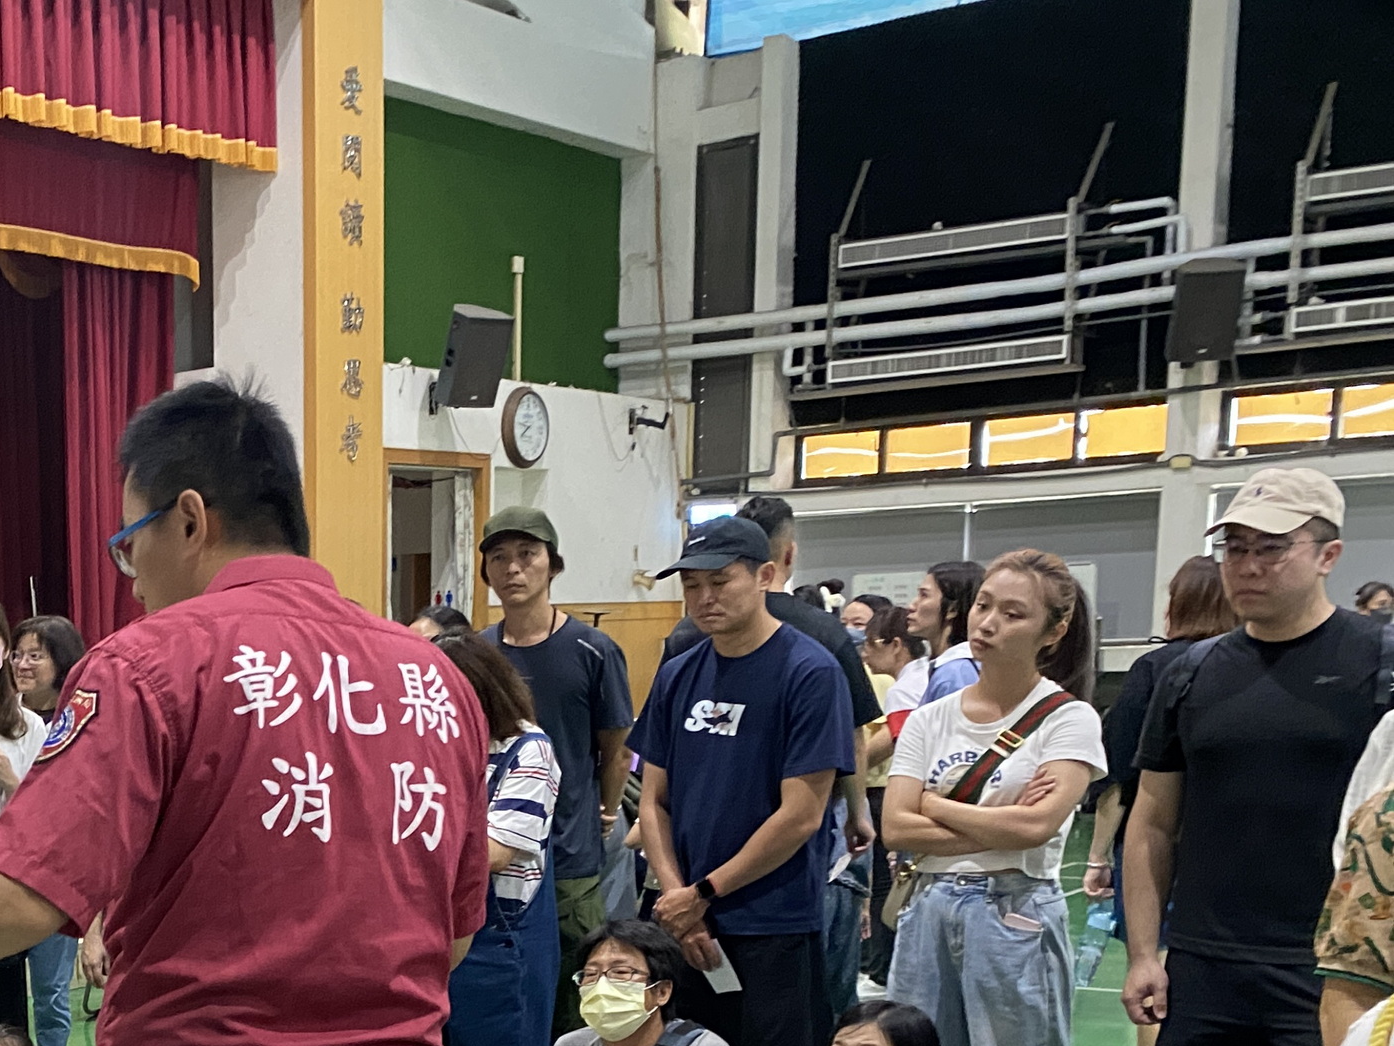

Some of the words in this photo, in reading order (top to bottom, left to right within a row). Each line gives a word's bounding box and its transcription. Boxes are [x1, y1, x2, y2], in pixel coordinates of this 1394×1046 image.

[223, 644, 461, 744] 彰化縣
[261, 751, 447, 852] 消防
[928, 750, 1003, 785] HARBR
